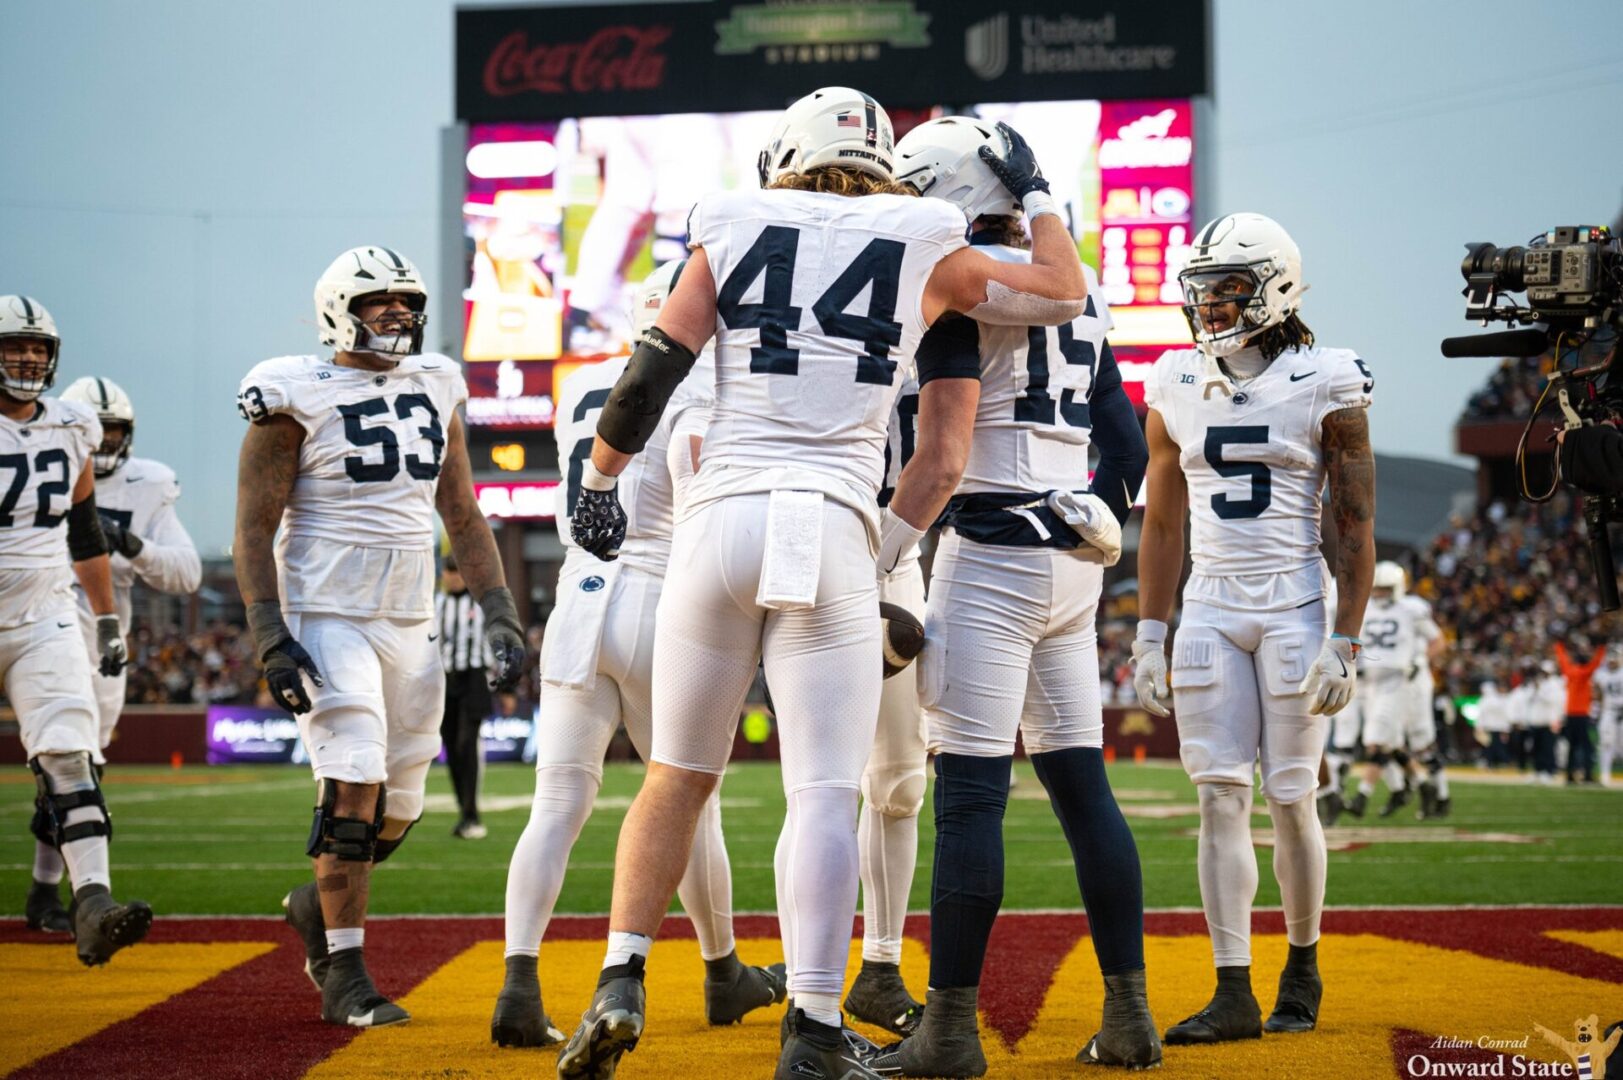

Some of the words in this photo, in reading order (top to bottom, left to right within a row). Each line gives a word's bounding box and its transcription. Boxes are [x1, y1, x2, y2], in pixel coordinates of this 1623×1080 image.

[1022, 12, 1116, 45] United
[1022, 46, 1175, 73] Healthcare
[839, 149, 877, 161] NITTANY
[717, 225, 906, 386] 44
[1014, 295, 1098, 428] 15
[1354, 359, 1374, 393] 5
[337, 393, 444, 483] 53
[0, 448, 70, 528] 72
[1204, 425, 1271, 519] 5
[1280, 639, 1304, 682] 5
